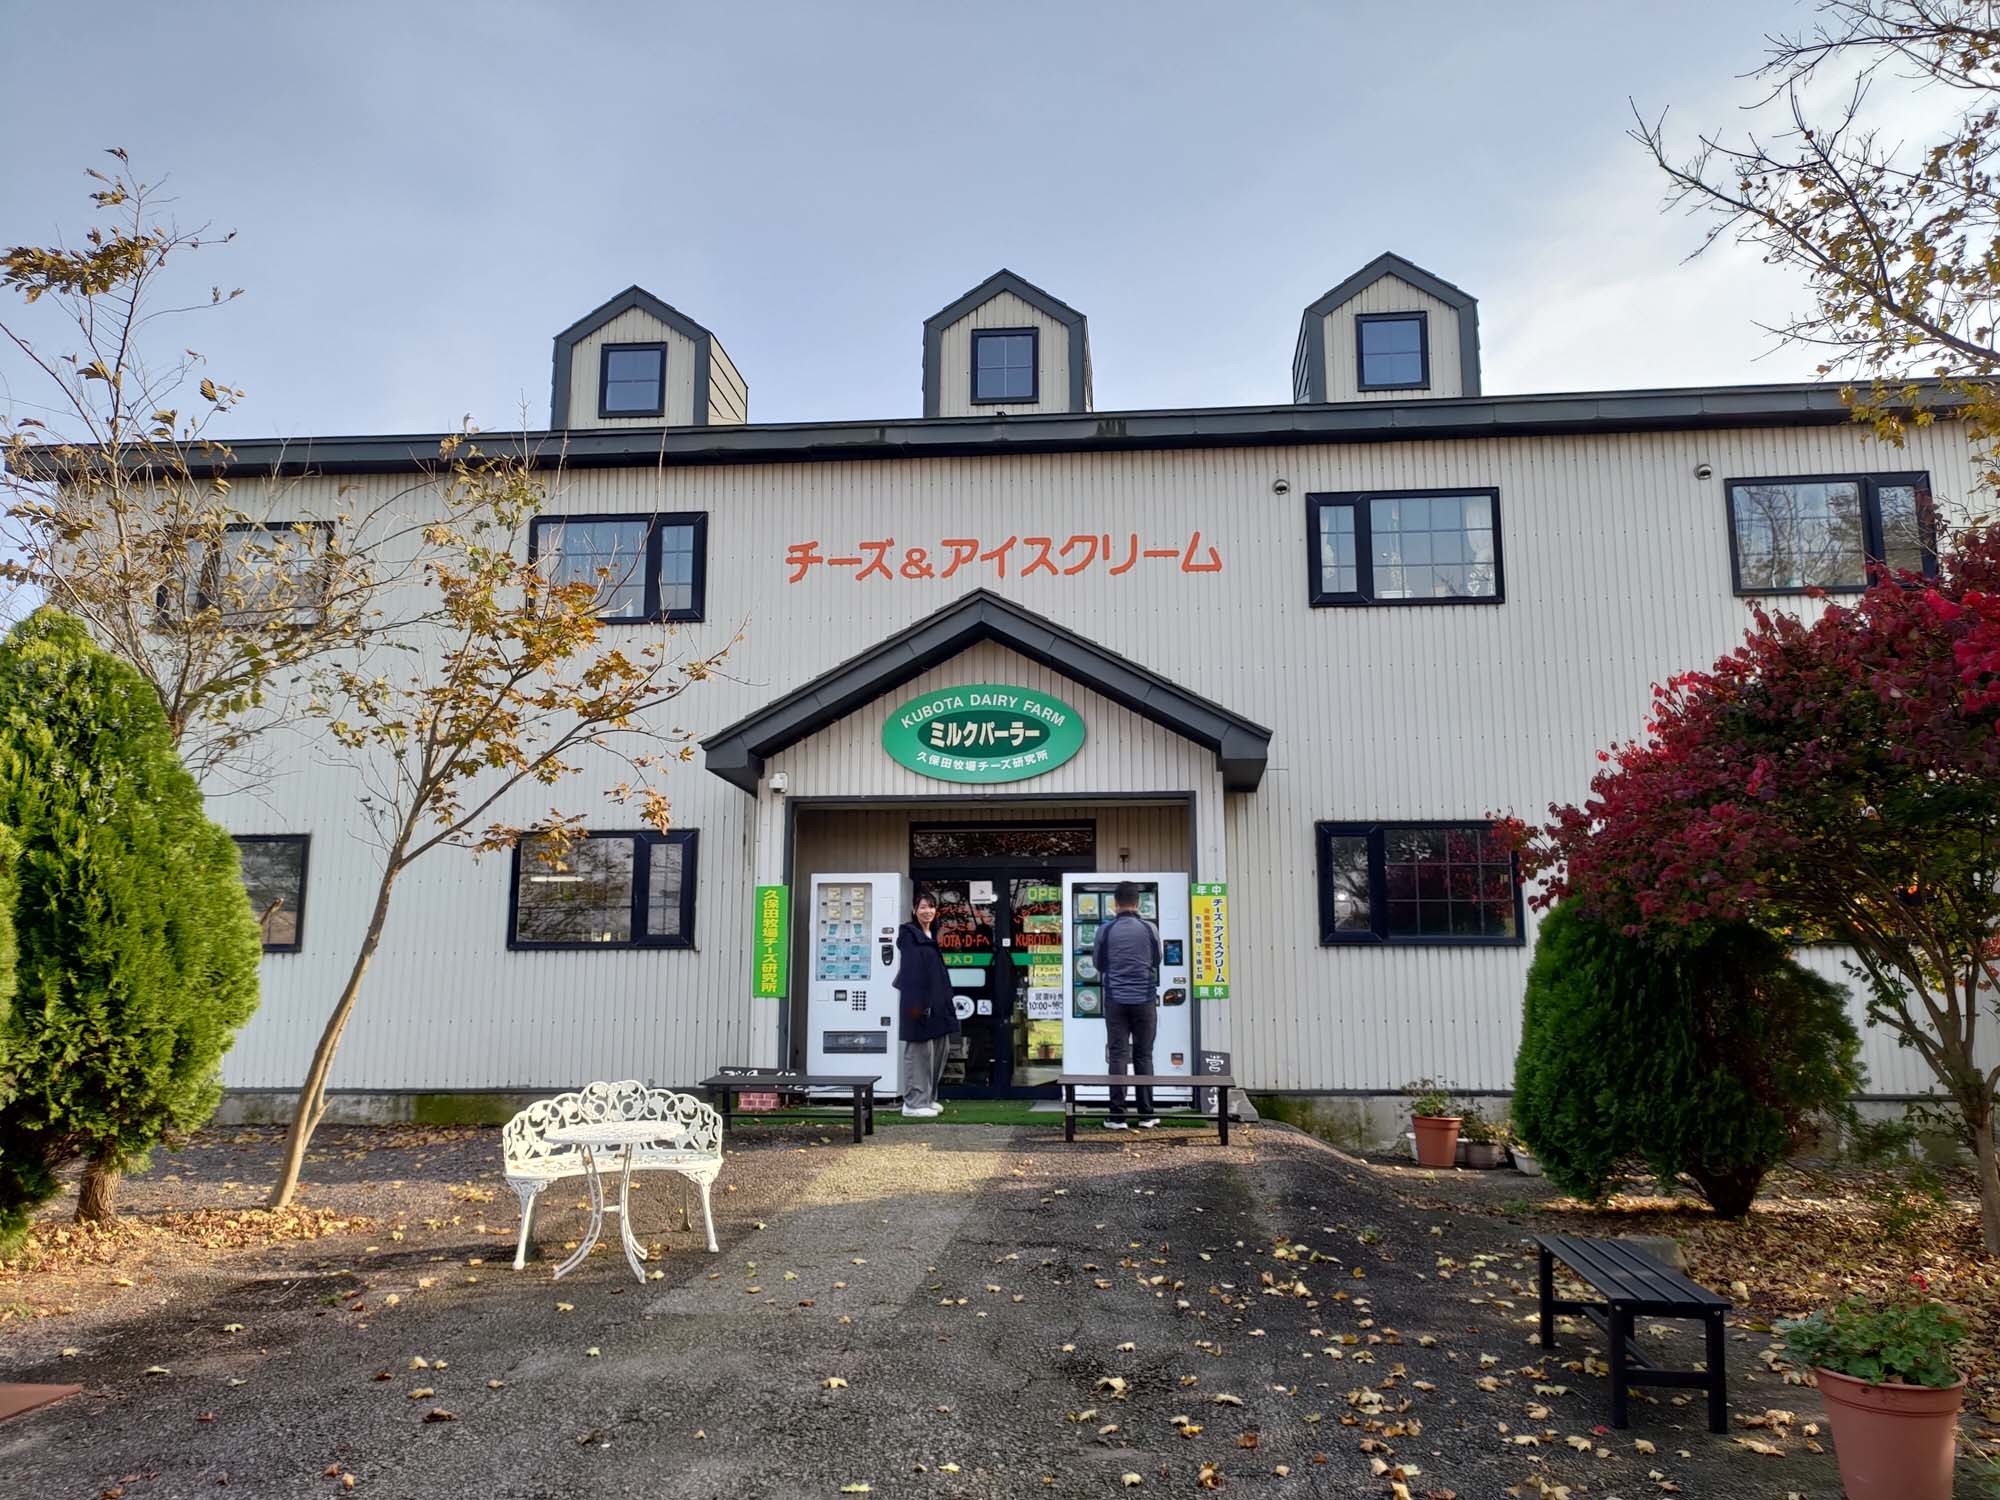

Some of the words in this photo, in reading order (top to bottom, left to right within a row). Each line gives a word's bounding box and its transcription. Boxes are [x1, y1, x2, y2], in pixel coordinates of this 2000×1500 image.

[785, 531, 1223, 584] チーズ&アイスクリーム
[901, 697, 964, 729] KUBOTA
[970, 693, 1018, 708] DAIRY
[1023, 699, 1066, 727] FARM
[929, 720, 1041, 748] ミルクパーラー
[916, 750, 1049, 772] 久保田牧場チーズ研究所
[1027, 886, 1062, 901] OPE
[761, 888, 780, 993] 久保田牧場チーズ研究所
